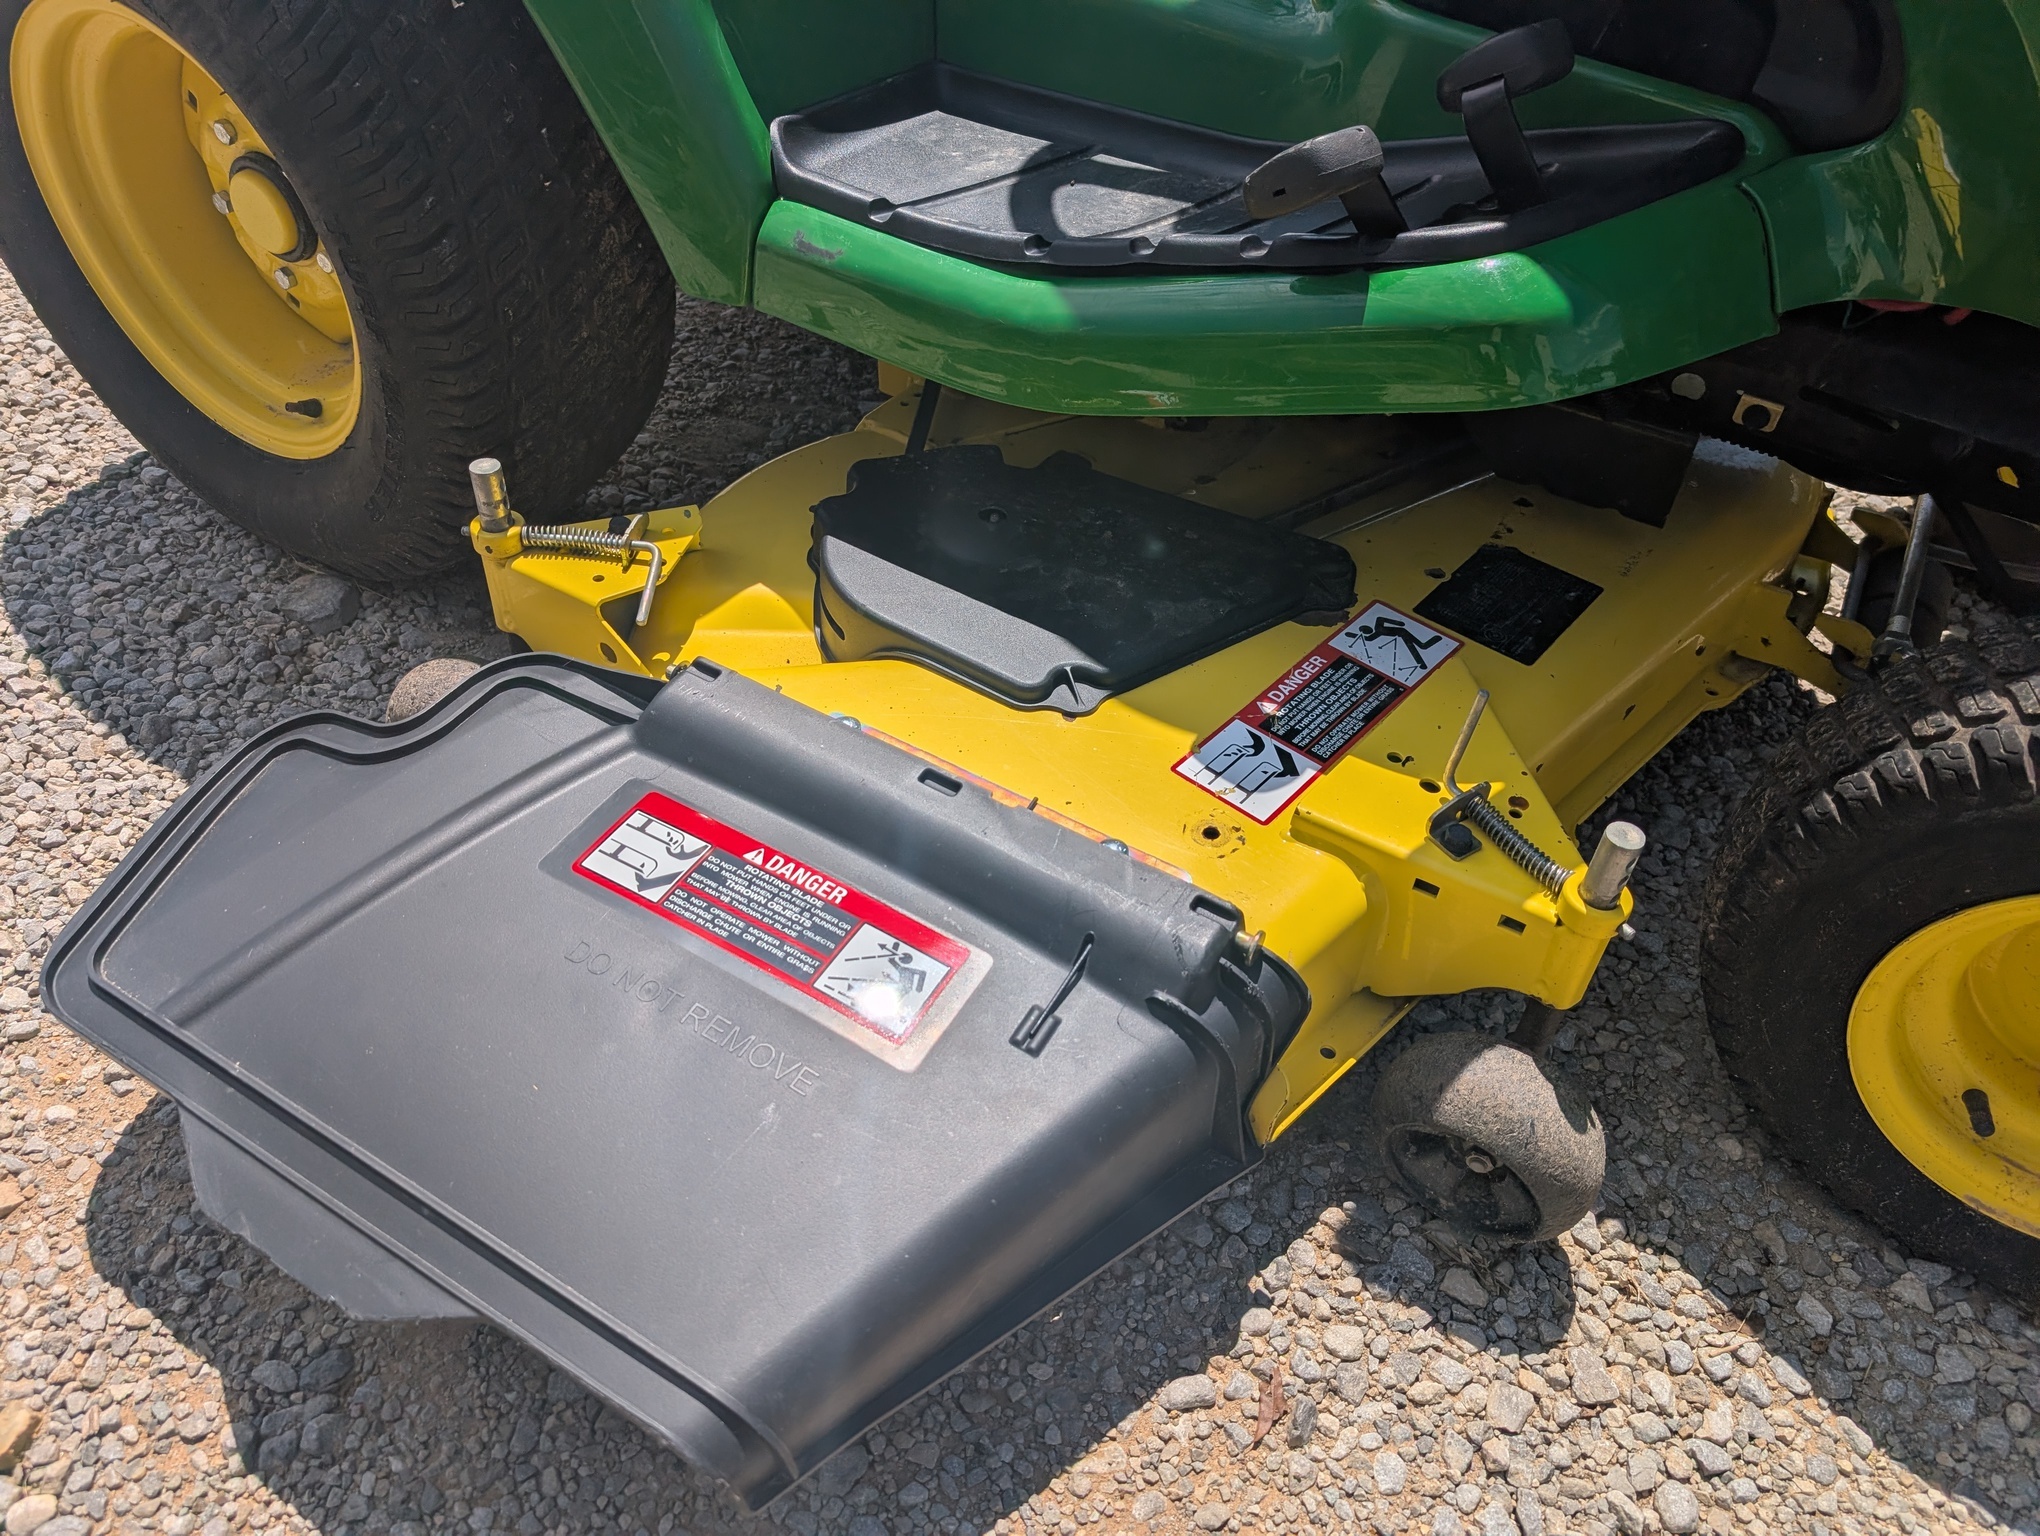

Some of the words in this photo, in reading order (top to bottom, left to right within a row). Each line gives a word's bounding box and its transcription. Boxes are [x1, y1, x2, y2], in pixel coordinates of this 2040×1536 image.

[1267, 655, 1327, 701] DANGER
[1276, 688, 1312, 716] ROTATING
[1310, 668, 1335, 687] BLADE
[1279, 716, 1290, 724] NOT
[1288, 708, 1299, 716] PUT
[1297, 696, 1314, 708] HANDS
[1319, 680, 1332, 689] FEET
[1330, 668, 1346, 680] UNDER
[1295, 704, 1327, 730] THROWN
[1325, 678, 1357, 703] OBJECTS
[1277, 725, 1290, 734] INTO
[1288, 710, 1307, 725] MOWER
[1305, 699, 1320, 710] WHEN
[1318, 686, 1336, 699] ENGINE
[1292, 728, 1310, 743] BEFORE
[1325, 702, 1340, 713] CLEAR
[1338, 693, 1351, 702] AREA
[1354, 673, 1374, 688] OBJECTS
[1298, 736, 1311, 746] THAT
[1310, 728, 1321, 736] MAY
[1326, 706, 1346, 722] THROWN
[1350, 688, 1366, 700] BLADE
[1310, 744, 1321, 752] DO
[1319, 736, 1330, 744] NOT
[1329, 717, 1352, 735] OPERATE
[1350, 702, 1369, 716] MOWER
[1367, 685, 1388, 701] WITHOUT
[1317, 732, 1343, 754] DISCHARGE
[1342, 719, 1357, 732] CHUTE
[1355, 712, 1365, 720] OR
[1363, 700, 1380, 713] ENTIRE
[1378, 687, 1394, 700] GRASS
[1322, 739, 1345, 757] CATCHER
[1348, 721, 1364, 734] PLACE
[686, 878, 703, 888] THAT
[704, 887, 719, 896] MAY
[719, 894, 731, 903] BE
[731, 901, 762, 918] THROWN
[762, 916, 774, 925] BY
[774, 923, 797, 937] BLADE
[702, 861, 719, 871] INTO
[720, 870, 748, 886] MOWER
[749, 885, 772, 898] WHEN
[773, 897, 800, 912] ENGINE
[812, 917, 845, 935] RUNNING
[707, 854, 721, 864] DO
[720, 861, 736, 871] NOT
[736, 870, 751, 879] PUT
[752, 877, 778, 892] HANDS
[778, 890, 792, 900] OR
[791, 897, 811, 909] FEET
[811, 907, 838, 922] UNDER
[837, 921, 851, 930] OR
[724, 880, 766, 903] THROWN
[767, 901, 812, 926] OBJECTS
[744, 865, 790, 890] ROTATING
[791, 888, 824, 907] BLADE
[764, 855, 848, 903] DANGER
[663, 901, 696, 920] CATCHER
[695, 917, 705, 925] IN
[669, 895, 712, 920] DISCHARGE
[714, 919, 740, 934] CHUTE
[741, 932, 755, 942] OR
[756, 941, 784, 957] ENTIRE
[786, 956, 814, 973] GRASS
[673, 888, 688, 898] DO
[690, 897, 707, 907] NOT
[709, 907, 745, 927] OPERATE
[748, 927, 780, 946] MOWER
[782, 945, 819, 966] WITHOUT
[691, 872, 717, 887] BEFORE
[749, 902, 772, 915] CLEAR
[772, 914, 791, 925] AREA
[791, 923, 803, 932] OF
[802, 930, 835, 948] OBJECTS
[563, 940, 612, 976] DO
[611, 968, 686, 1013] NOT
[679, 1001, 821, 1097] REMOVE
